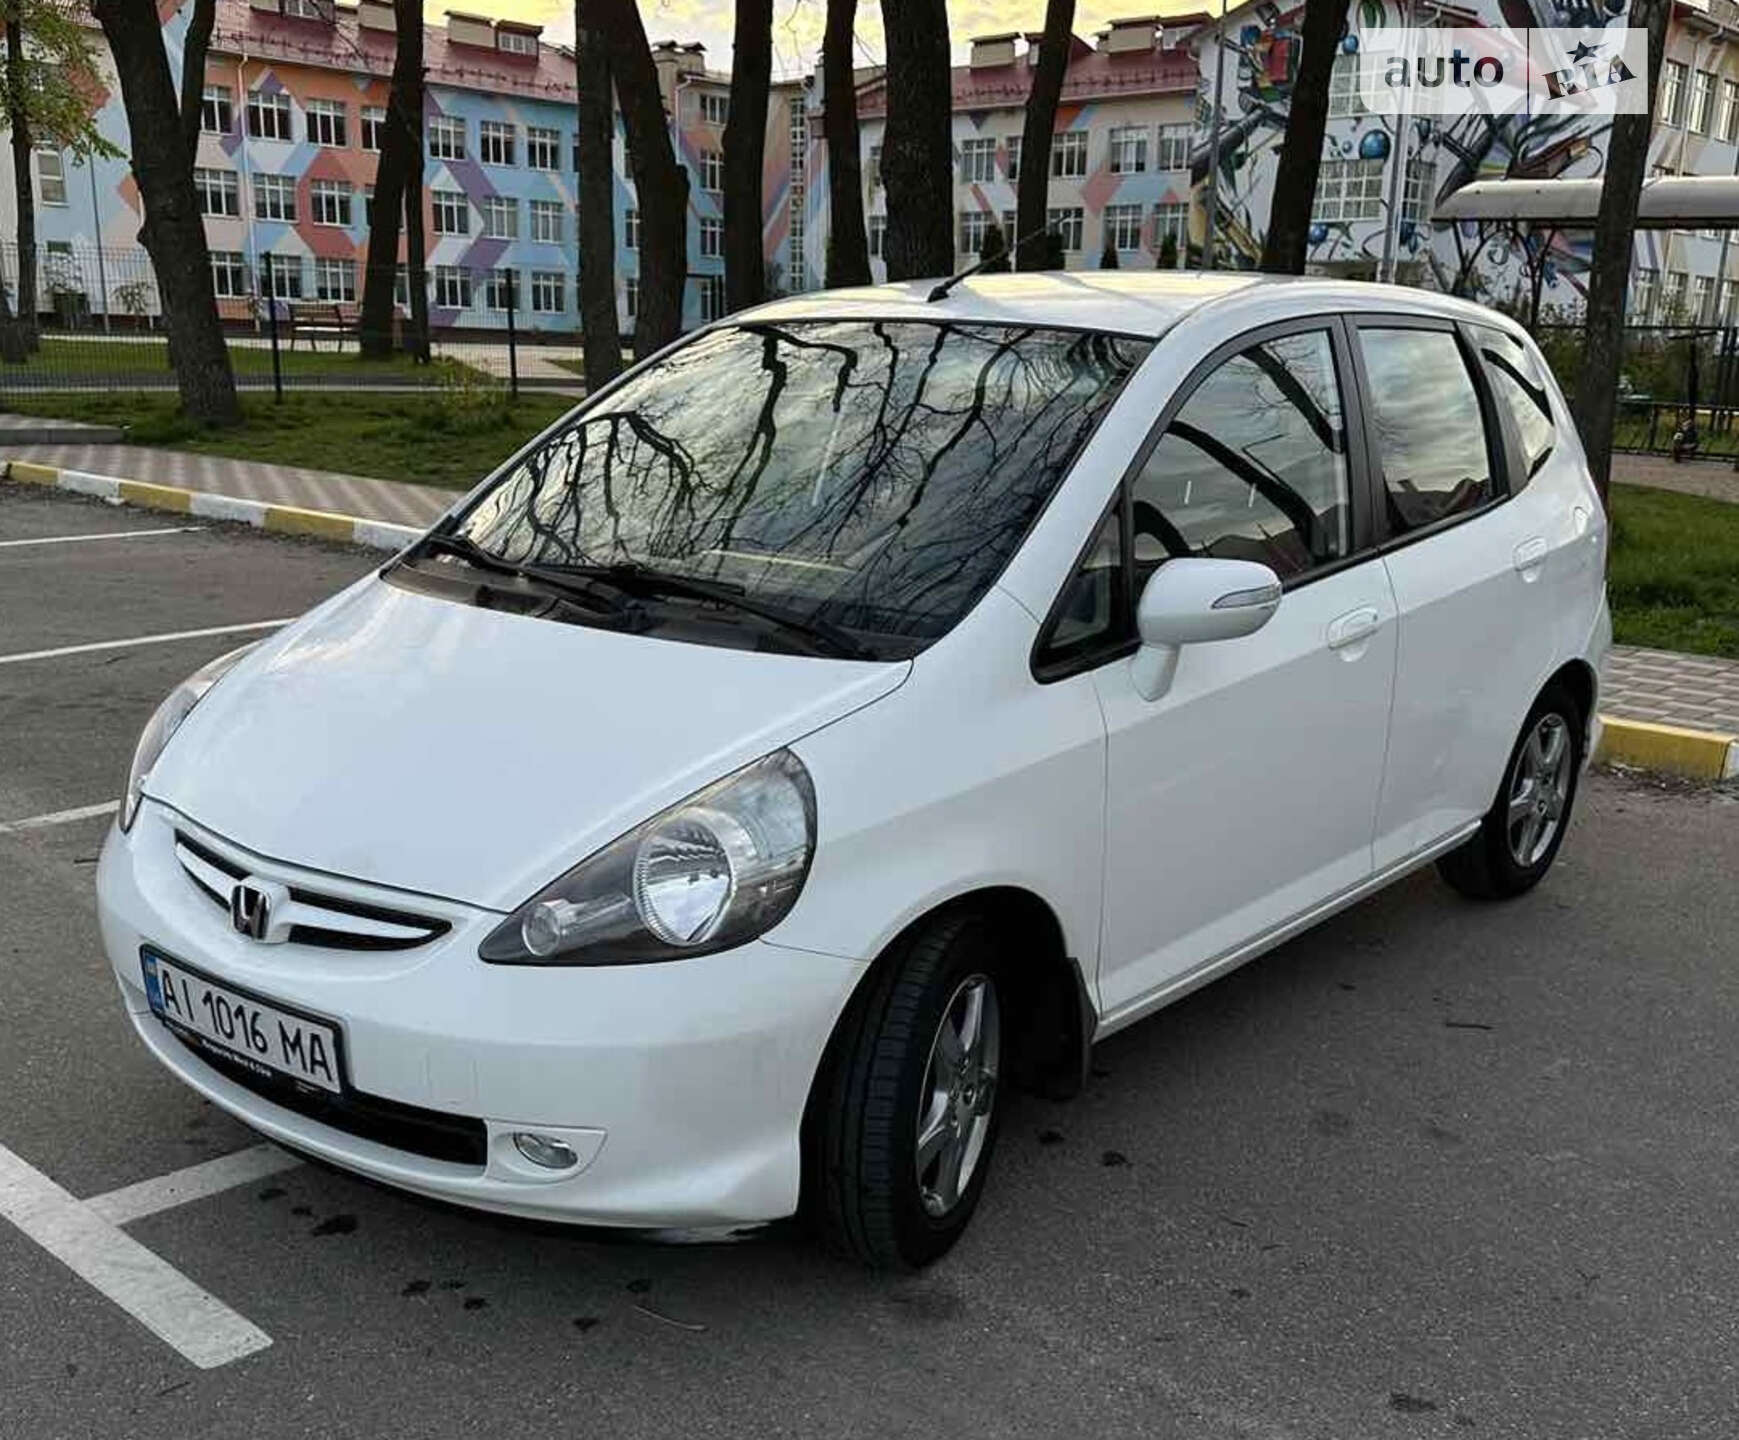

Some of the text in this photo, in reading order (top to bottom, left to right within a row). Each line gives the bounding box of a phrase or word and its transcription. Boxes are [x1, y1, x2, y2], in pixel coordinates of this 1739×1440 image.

[162, 970, 194, 1022] AI
[202, 990, 268, 1054] 1016
[278, 1020, 333, 1081] MA
